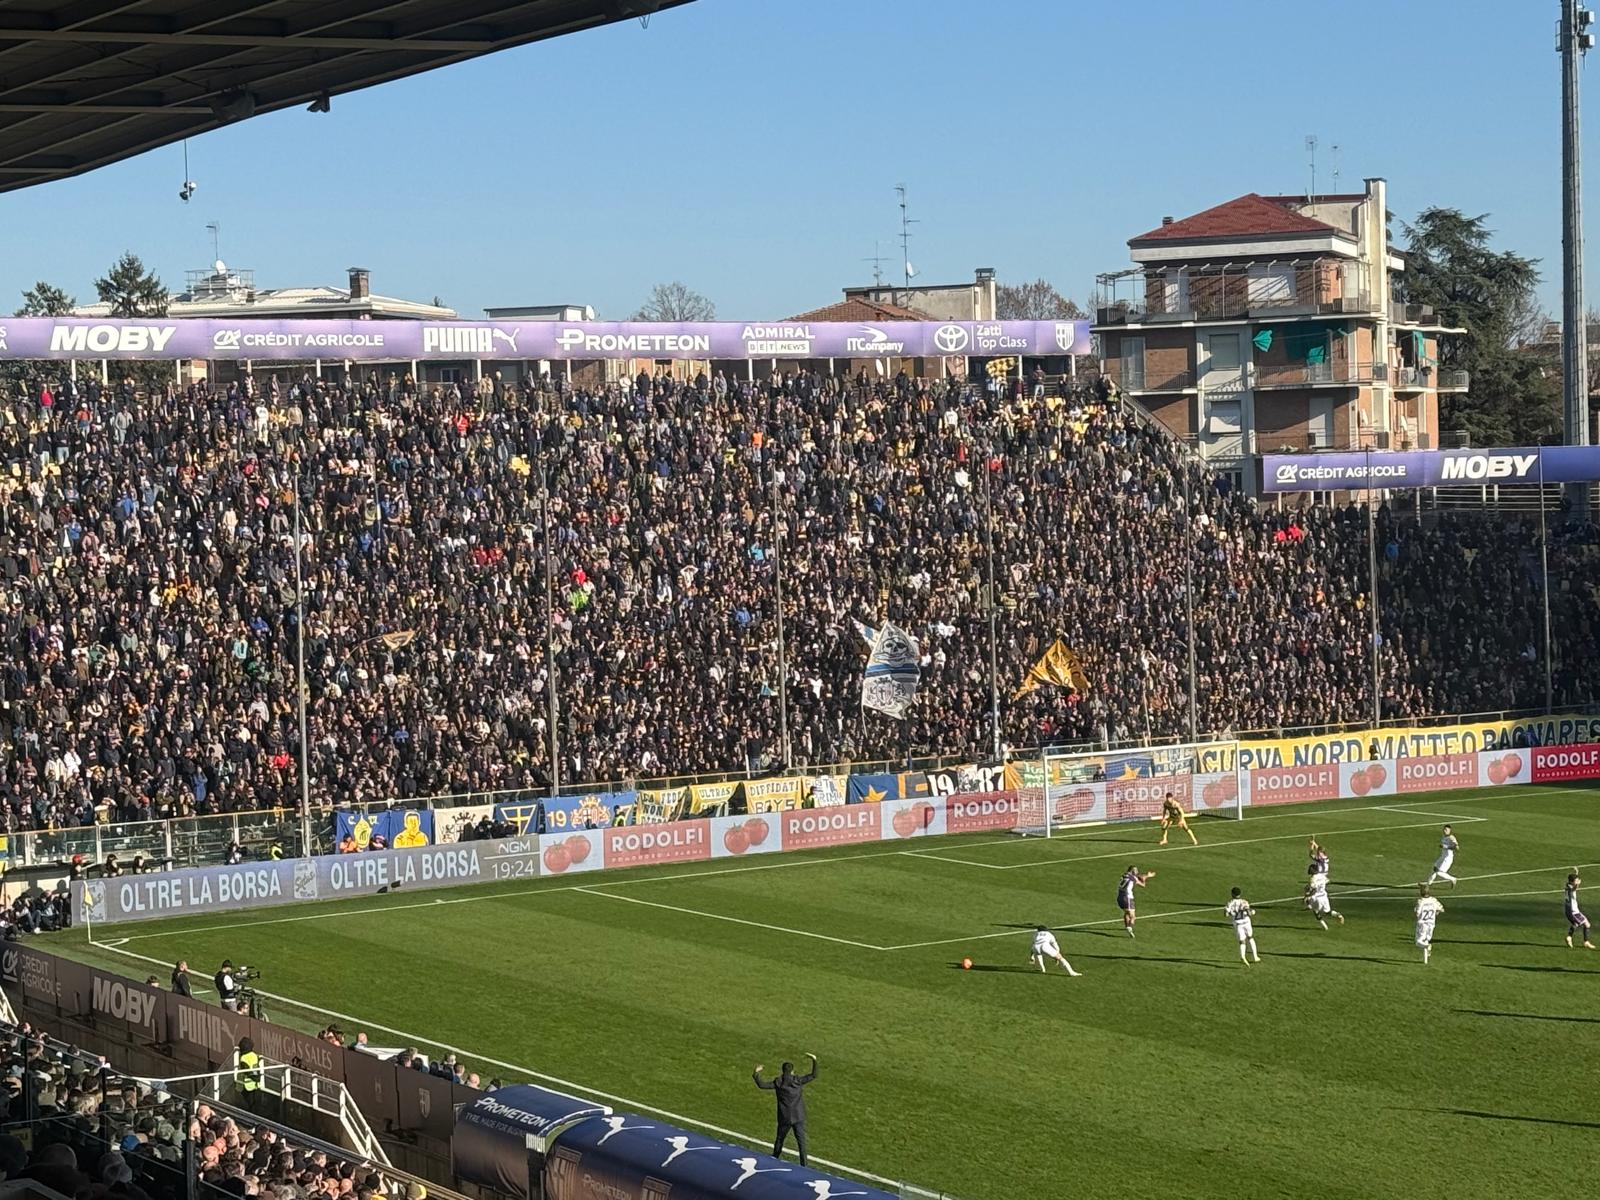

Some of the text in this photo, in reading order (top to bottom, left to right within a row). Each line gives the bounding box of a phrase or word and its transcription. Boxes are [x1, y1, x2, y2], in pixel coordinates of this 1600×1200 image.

[50, 325, 176, 351] MOBY
[243, 332, 302, 346] CRÉDIT
[304, 334, 384, 346] AGRICOLE
[555, 328, 710, 351] PROMETEON
[741, 325, 816, 340] ADMIRAL
[976, 325, 1002, 336] Zatti
[977, 337, 1027, 350] Top Class
[1299, 467, 1344, 479] CRÉDIT
[1345, 465, 1406, 478] AGRICOLE
[1441, 455, 1538, 480] MOBY
[1294, 739, 1363, 768] NORD
[1257, 772, 1333, 790] RODOLFI
[1402, 762, 1473, 780] RODOLFI
[547, 810, 567, 827] 19
[953, 797, 1036, 818] RODOLFI
[789, 811, 874, 834] RODOLFI
[612, 828, 703, 852] RODOLFI
[330, 849, 480, 889] OLTRE LA BORSA
[491, 859, 534, 879] 19:24
[120, 881, 182, 912] OLTRE
[189, 876, 213, 905] LA
[219, 869, 281, 900] BORSA
[92, 976, 157, 1028] MOBY
[283, 1036, 303, 1059] GAS
[305, 1043, 333, 1071] SALES
[474, 1096, 550, 1128] PROMETEON
